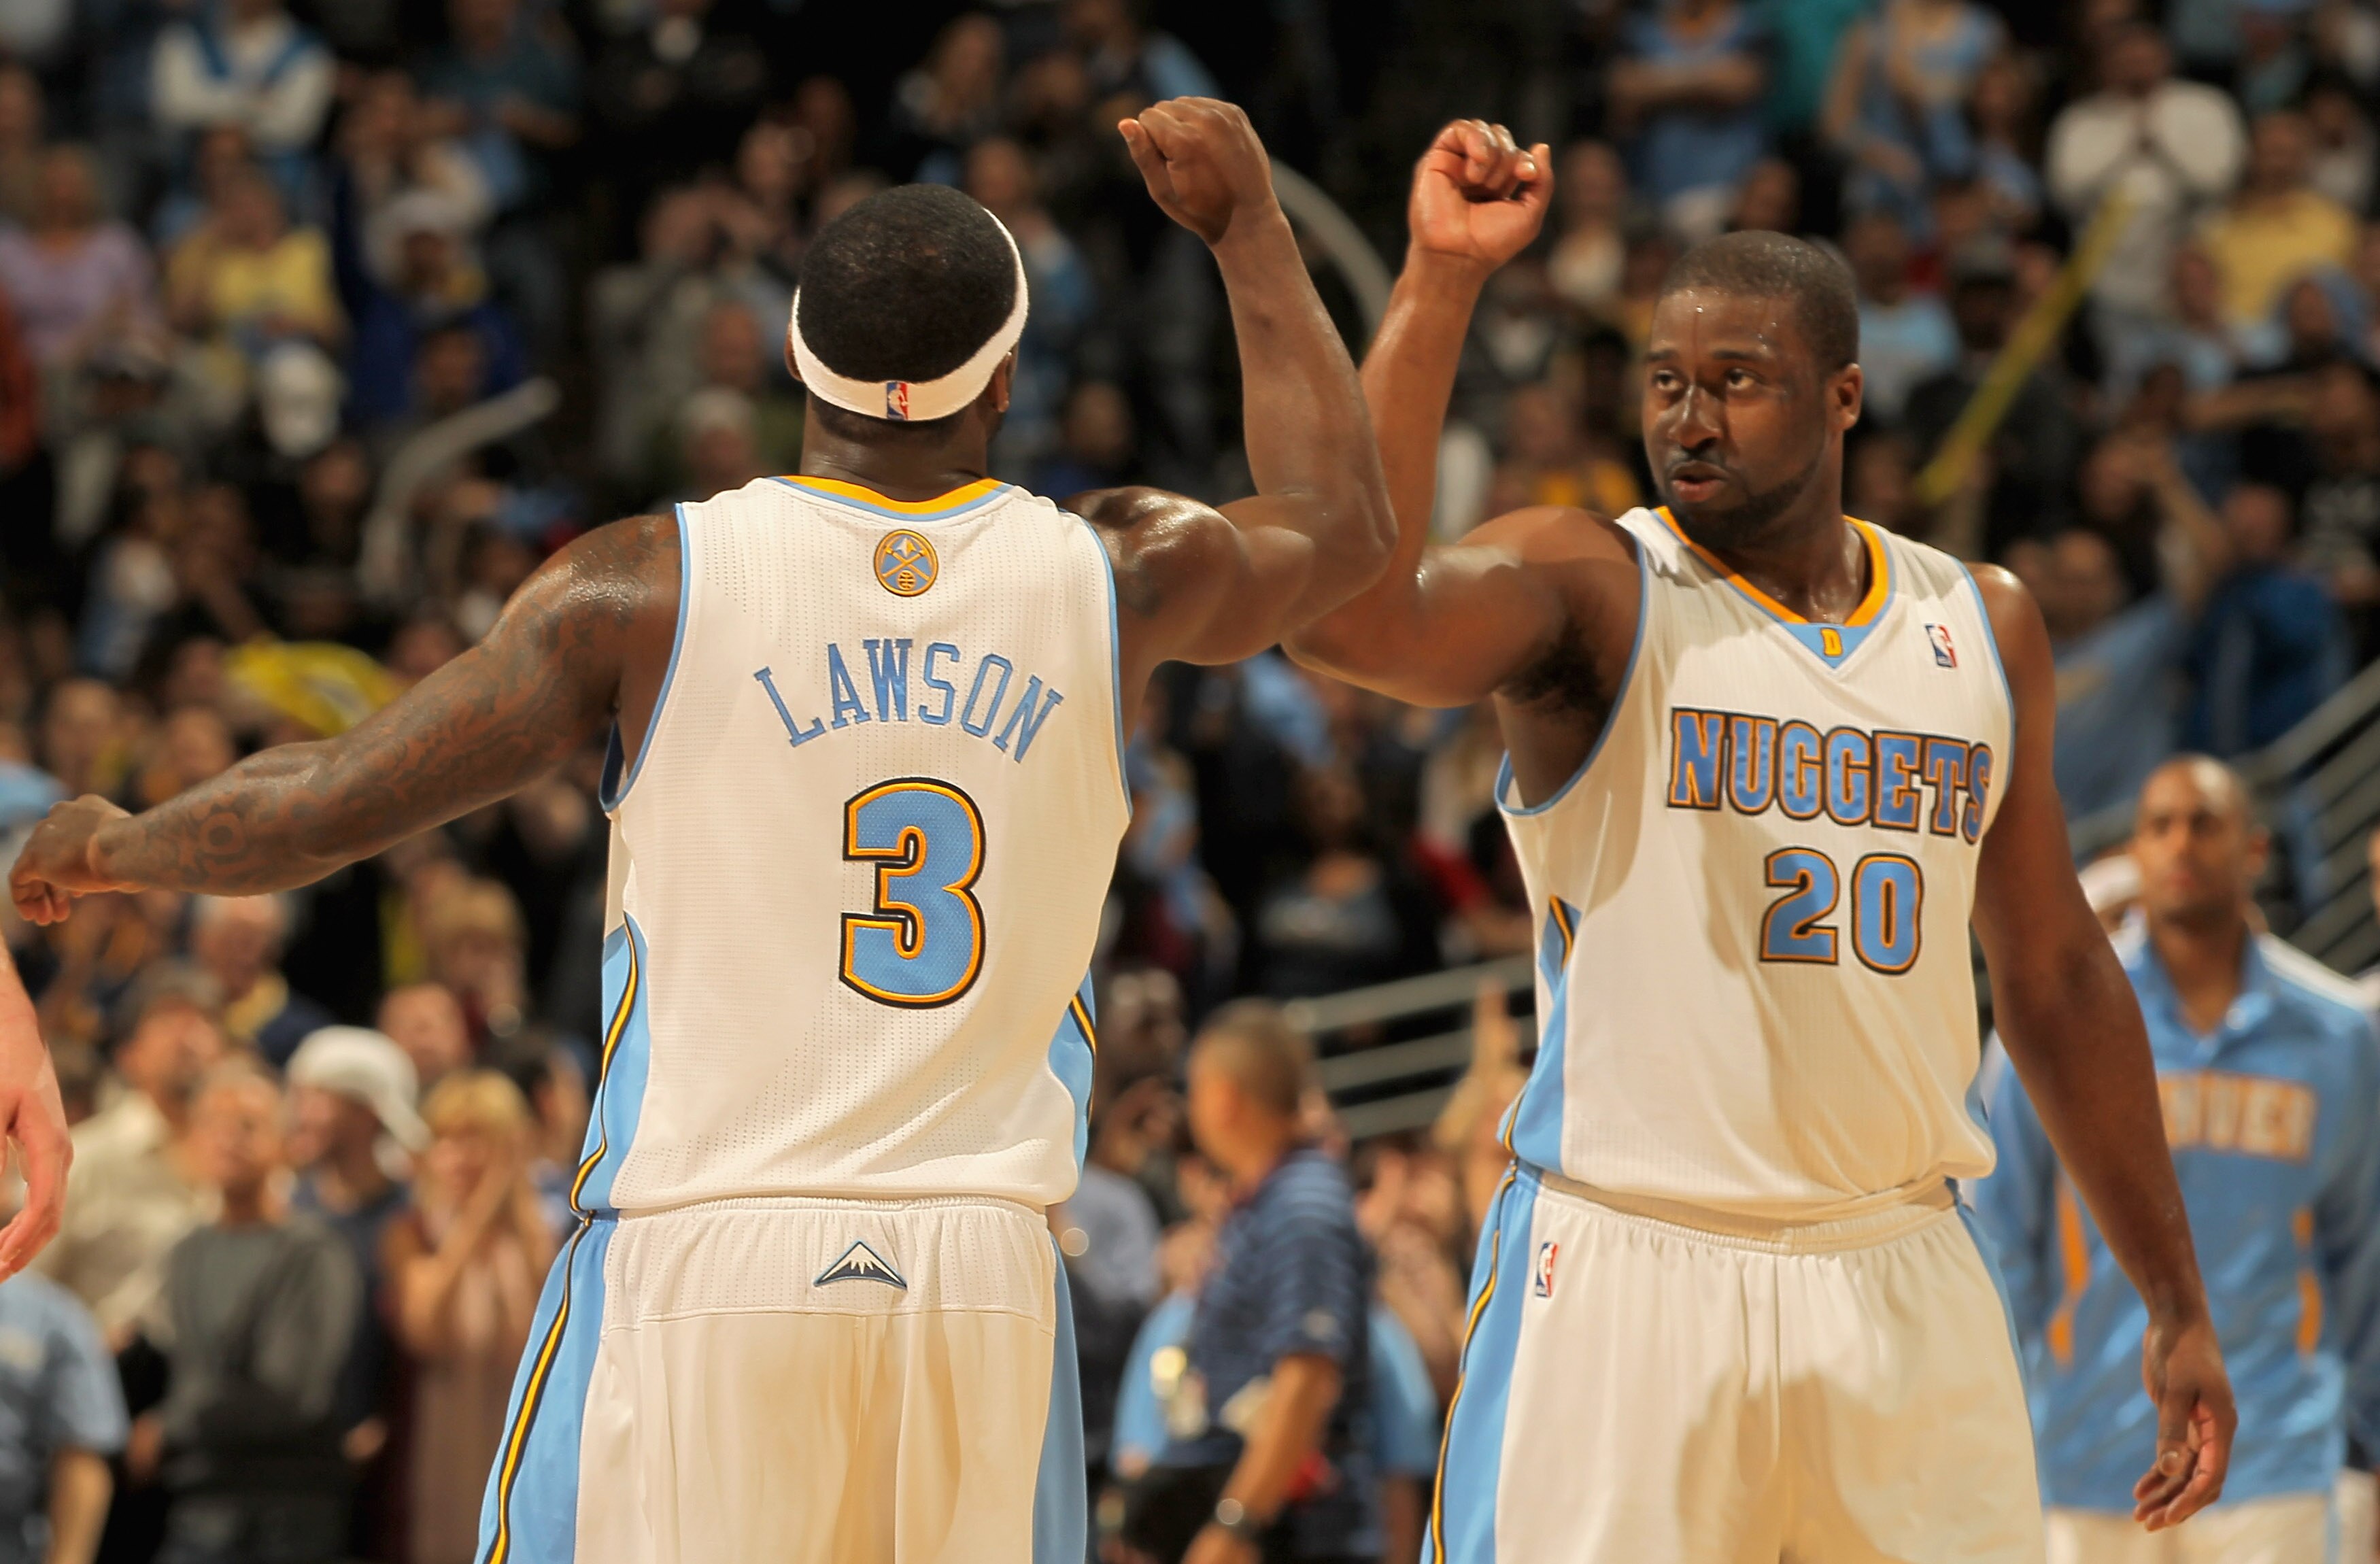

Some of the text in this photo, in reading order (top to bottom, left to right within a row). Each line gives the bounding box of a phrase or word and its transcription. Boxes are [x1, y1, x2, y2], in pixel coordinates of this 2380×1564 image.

[753, 638, 1064, 764] LAWSON
[1820, 627, 1843, 657] D
[1667, 707, 1994, 845] NUGGETS
[838, 777, 986, 1009] 3
[1759, 847, 1924, 975] 20
